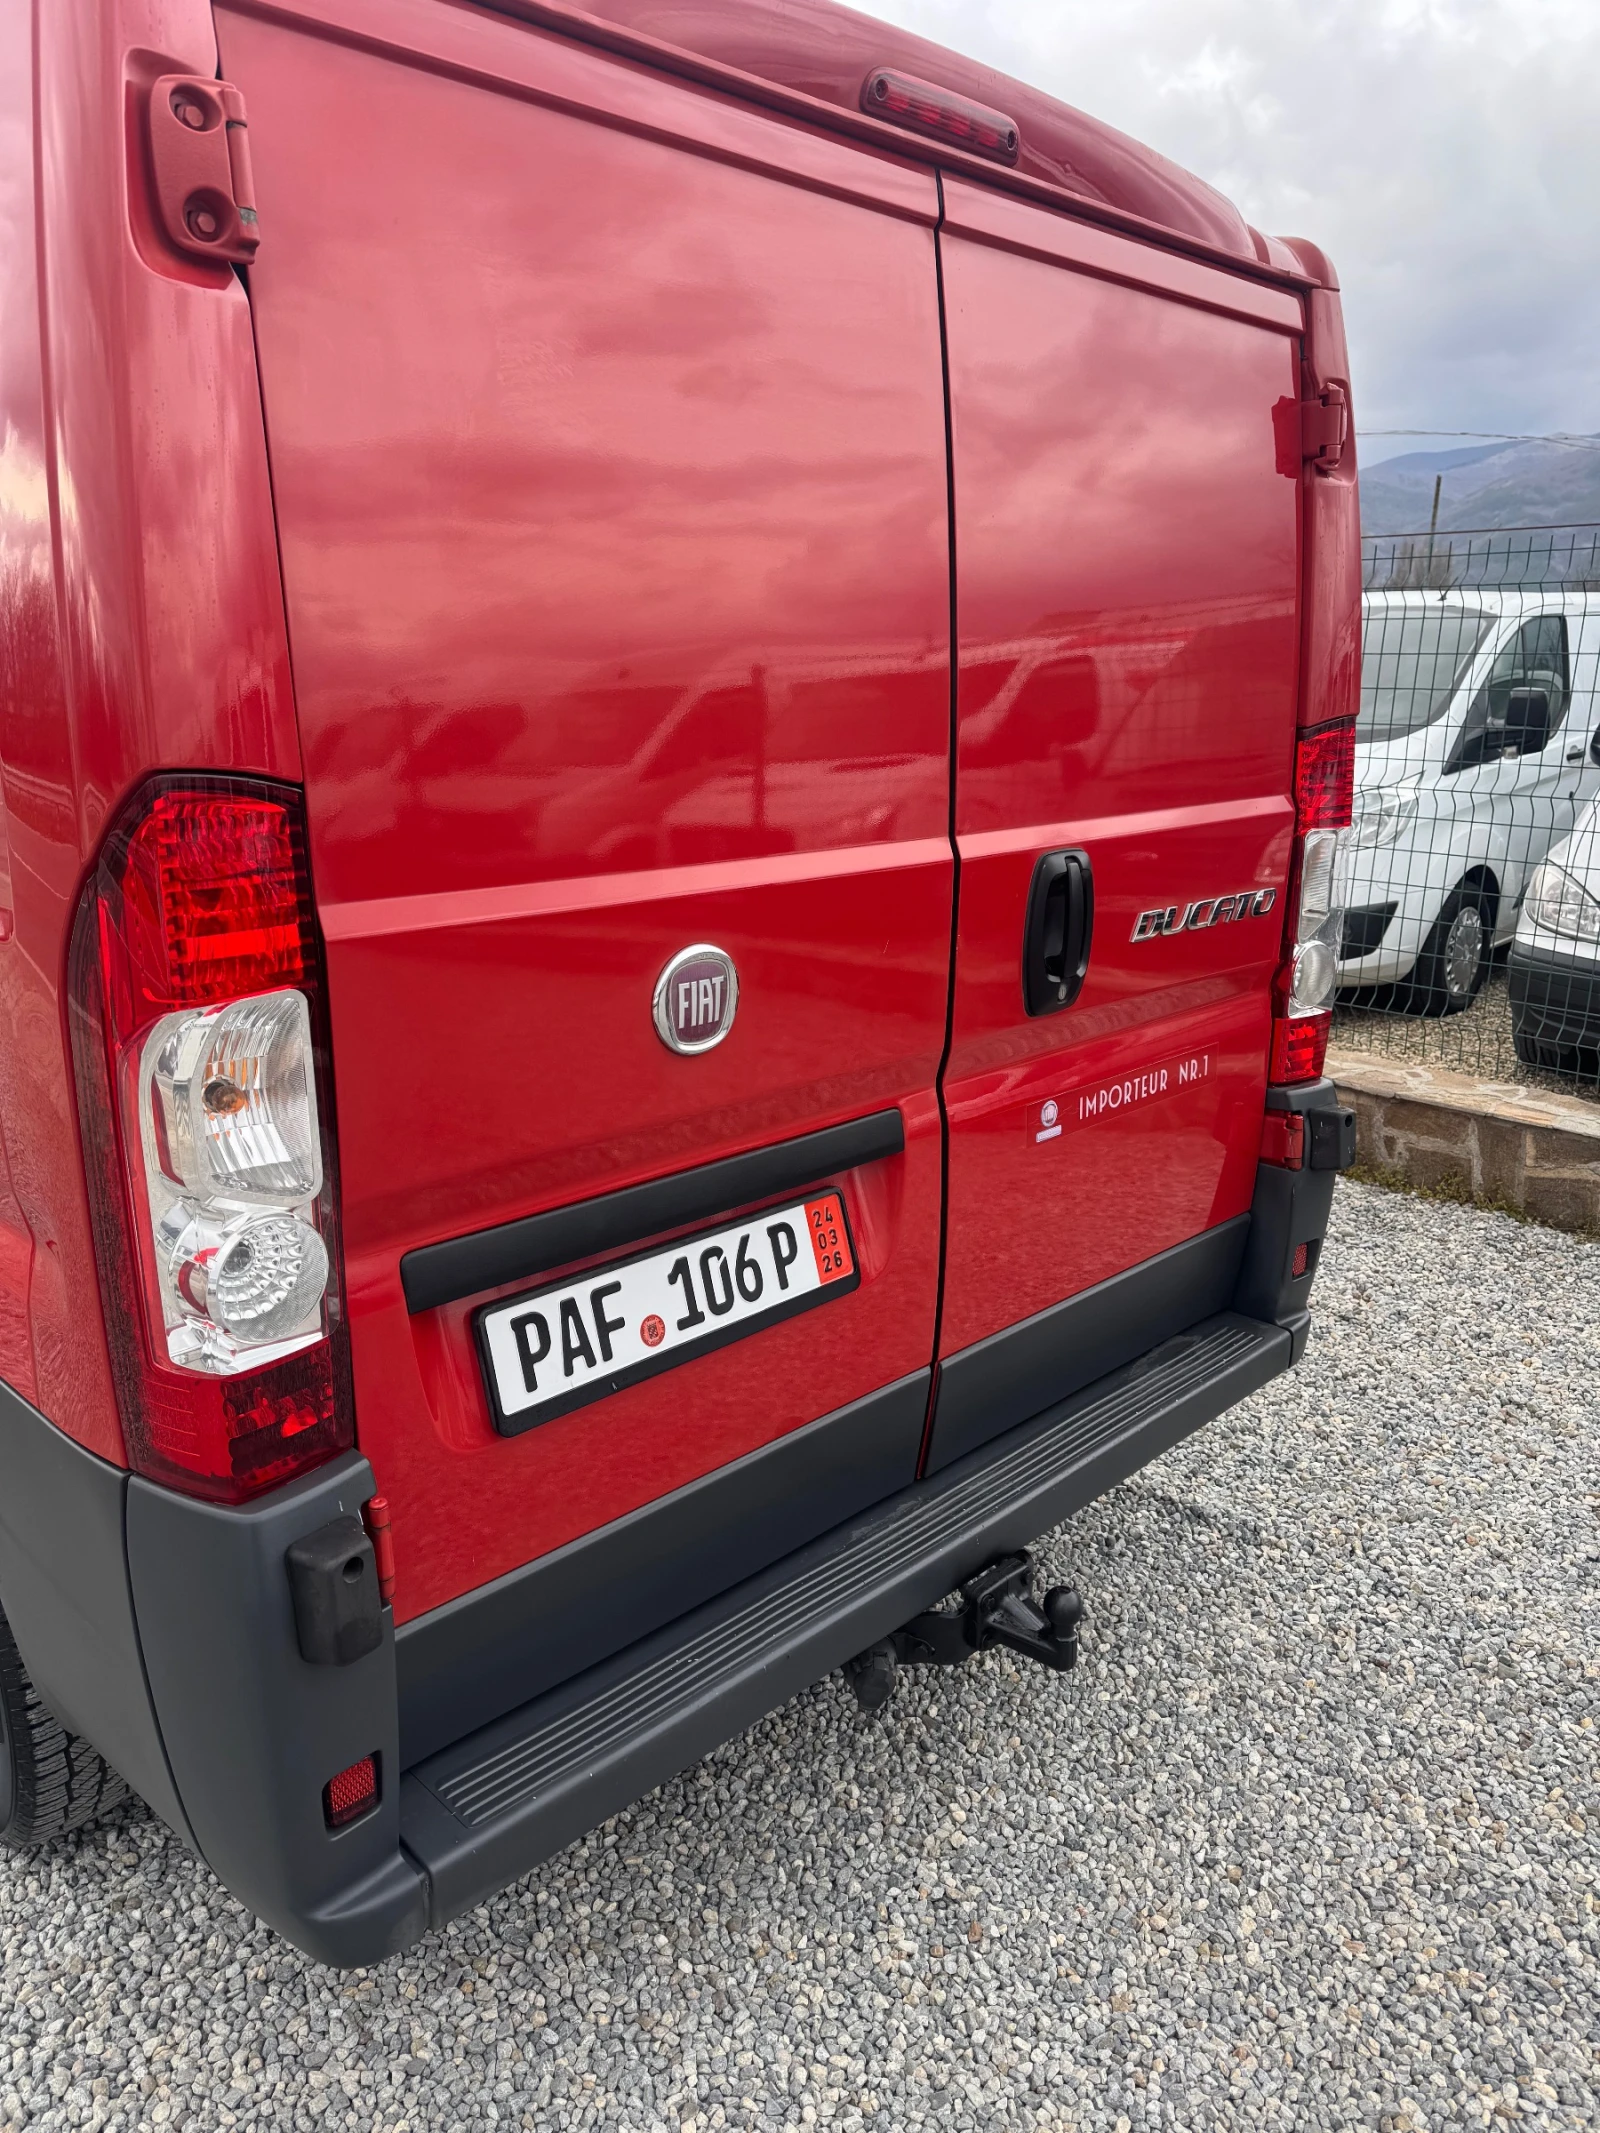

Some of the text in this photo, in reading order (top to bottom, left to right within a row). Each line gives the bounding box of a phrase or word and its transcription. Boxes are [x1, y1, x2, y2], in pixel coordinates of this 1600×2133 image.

[1129, 887, 1276, 942] DUCATO
[678, 975, 724, 1029] FIAT
[1079, 1069, 1168, 1120] IMPORTEUR
[1178, 1054, 1209, 1085] NR.1
[812, 1206, 834, 1228] 24
[817, 1231, 839, 1250] 03
[821, 1250, 843, 1273] 26
[509, 1221, 798, 1393] PAF 106 P
